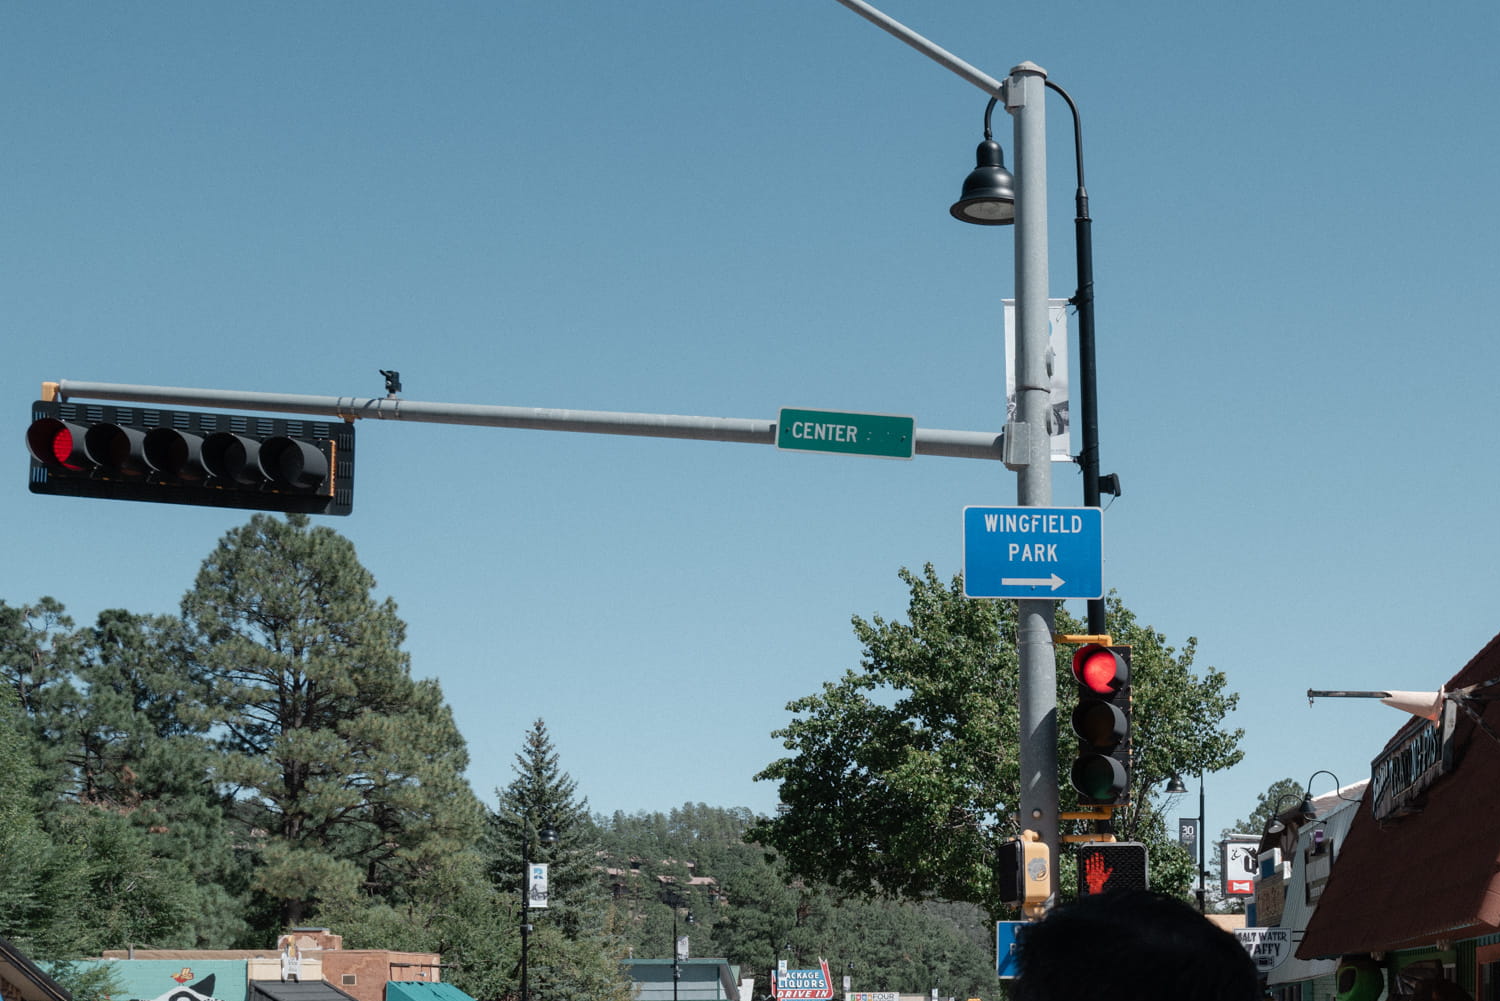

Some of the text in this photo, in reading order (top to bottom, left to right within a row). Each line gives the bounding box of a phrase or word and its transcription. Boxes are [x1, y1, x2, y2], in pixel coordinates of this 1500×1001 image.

[792, 421, 857, 443] CENTER
[984, 514, 1083, 534] WINGFIELD
[1008, 543, 1058, 562] PARK
[1238, 931, 1287, 943] SALT WATER
[778, 979, 825, 988] LIQUORS
[777, 990, 829, 998] DRIVE IN
